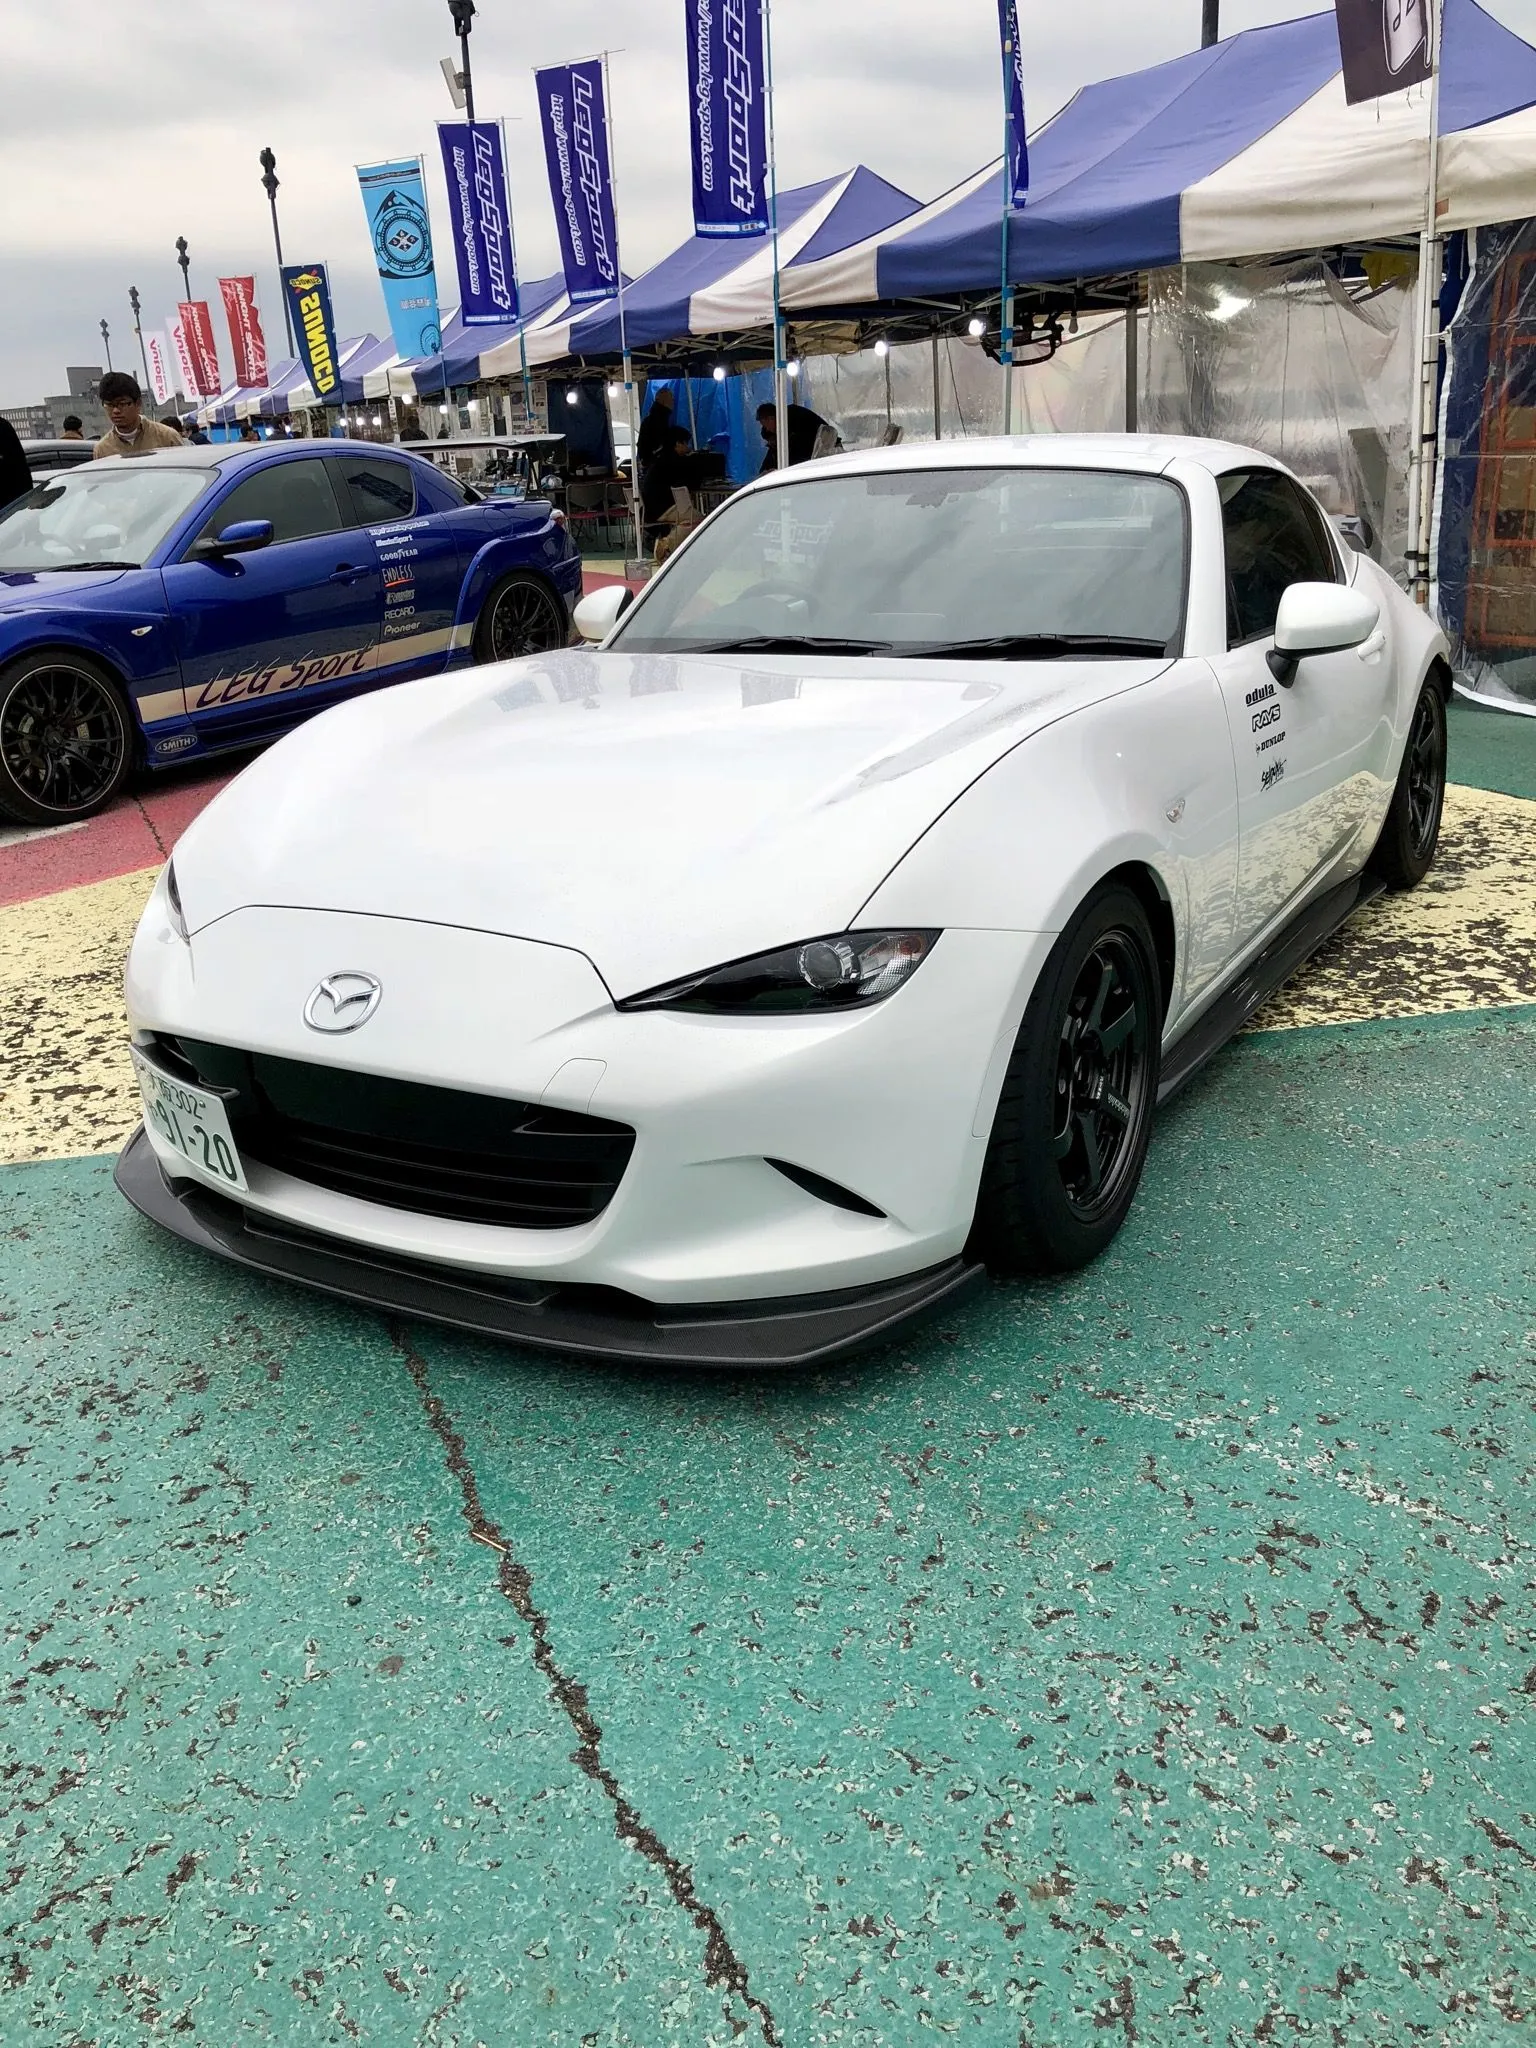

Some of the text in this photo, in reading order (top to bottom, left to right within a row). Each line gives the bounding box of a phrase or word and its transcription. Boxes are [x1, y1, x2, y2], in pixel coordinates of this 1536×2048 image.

[572, 72, 615, 281] LegSport
[472, 130, 511, 310] LegSport
[190, 306, 205, 347] KNIGHT
[200, 347, 216, 391] SPORTS
[235, 282, 251, 328] KNIGHT
[245, 331, 258, 383] SPORTS
[382, 563, 415, 583] ENDLESS
[384, 606, 415, 620] RECARO
[384, 621, 421, 636] Pioneer
[196, 639, 374, 709] LEG Sport
[1245, 684, 1275, 705] odula
[1252, 703, 1281, 733] RAYS
[162, 737, 191, 751] SMITH
[1261, 731, 1286, 751] DUNLOP
[171, 1085, 203, 1120] 302
[156, 1099, 238, 1182] 91-20
